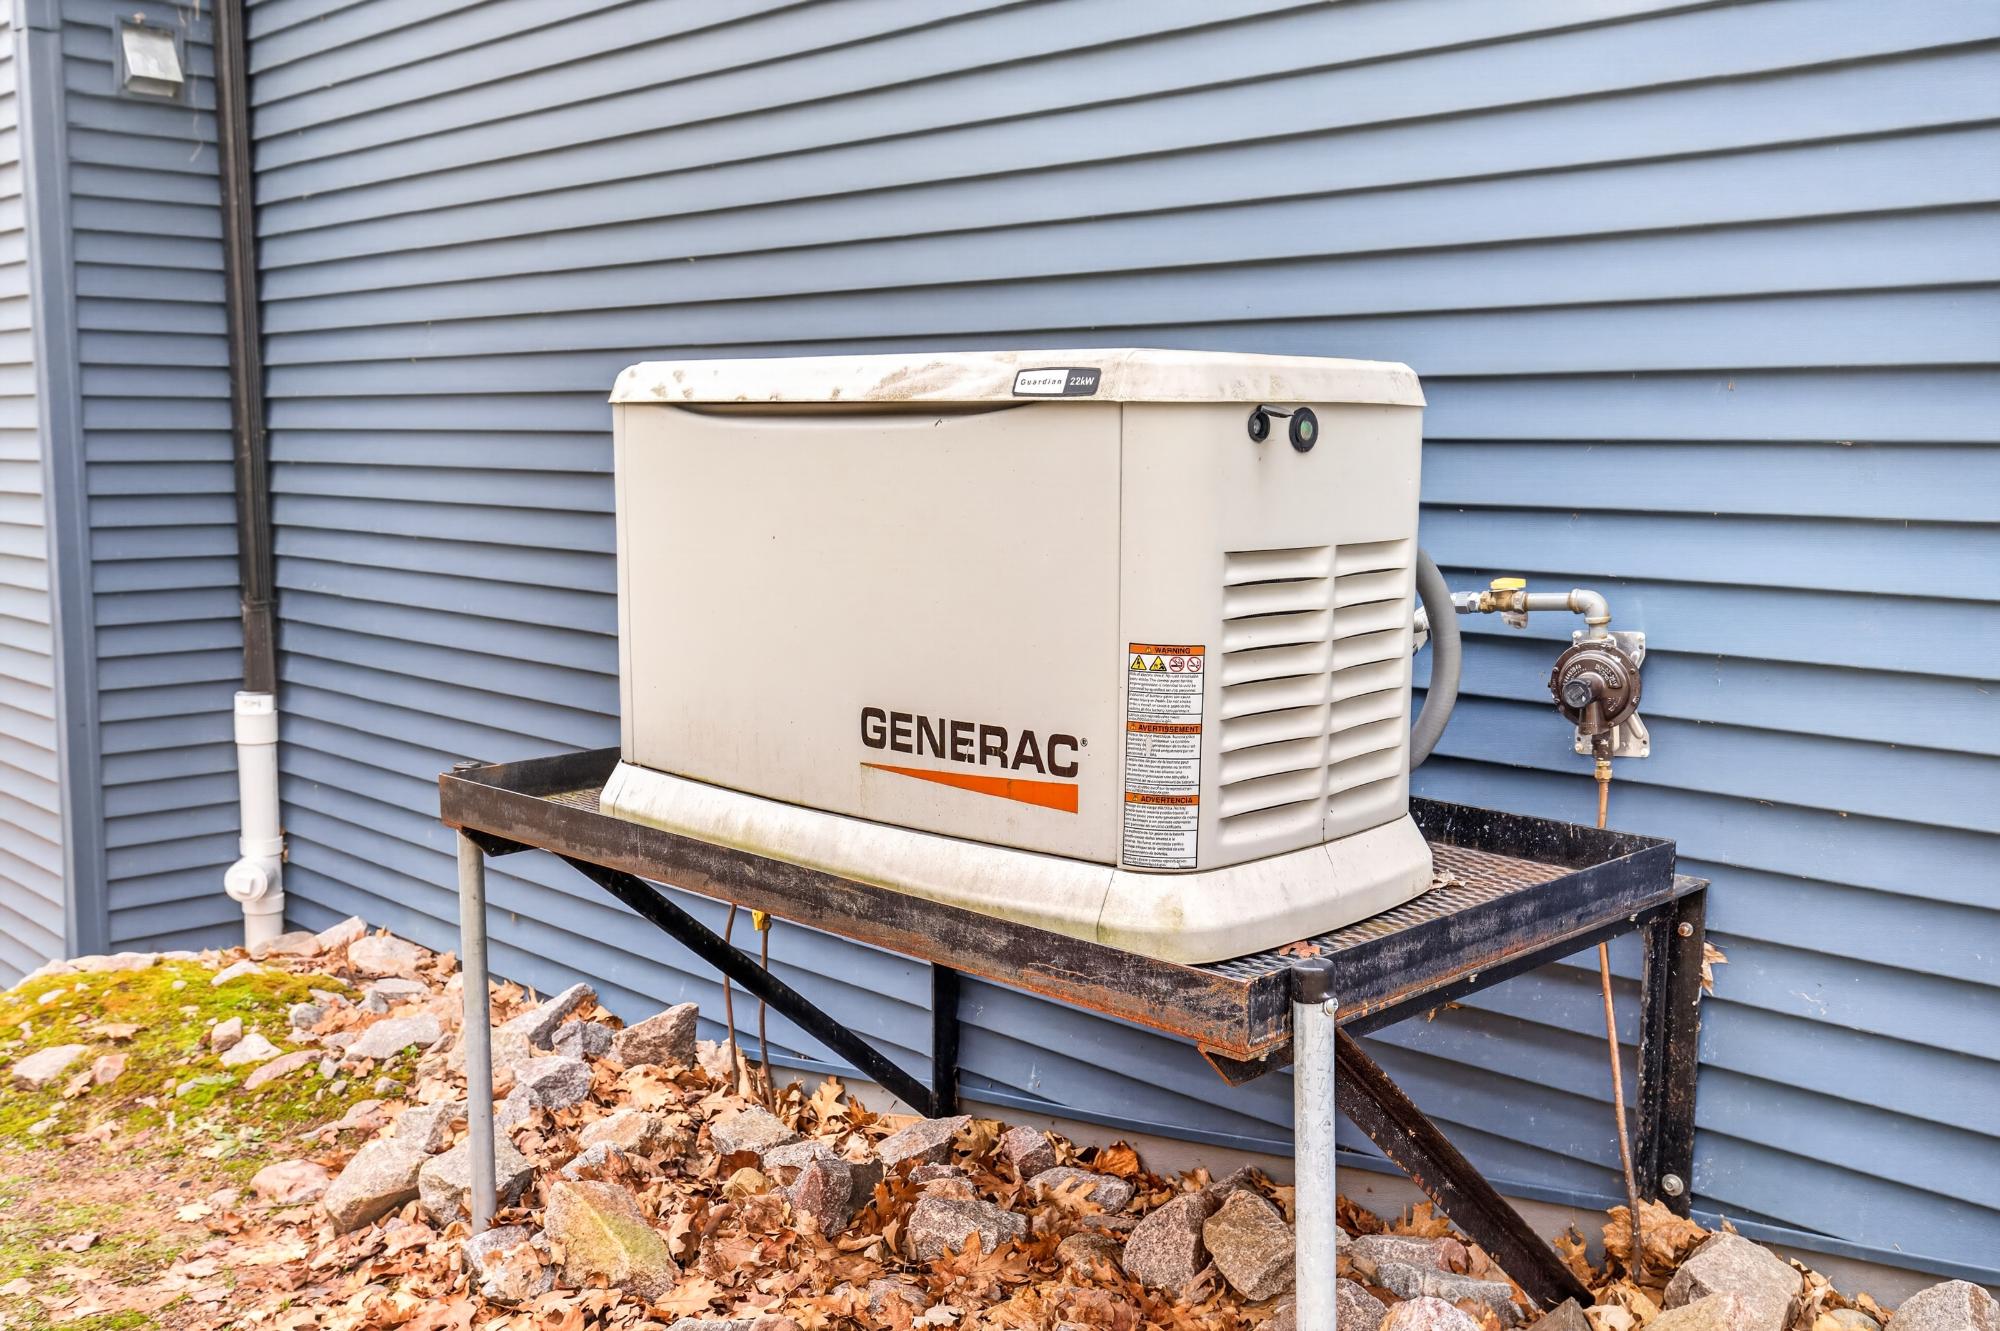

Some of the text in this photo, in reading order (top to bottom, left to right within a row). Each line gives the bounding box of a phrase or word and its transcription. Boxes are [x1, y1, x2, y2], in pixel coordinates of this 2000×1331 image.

[1020, 376, 1095, 386] Guardian 22kW
[1154, 647, 1191, 655] WARNING
[1138, 724, 1199, 733] AVERTISSEMENT
